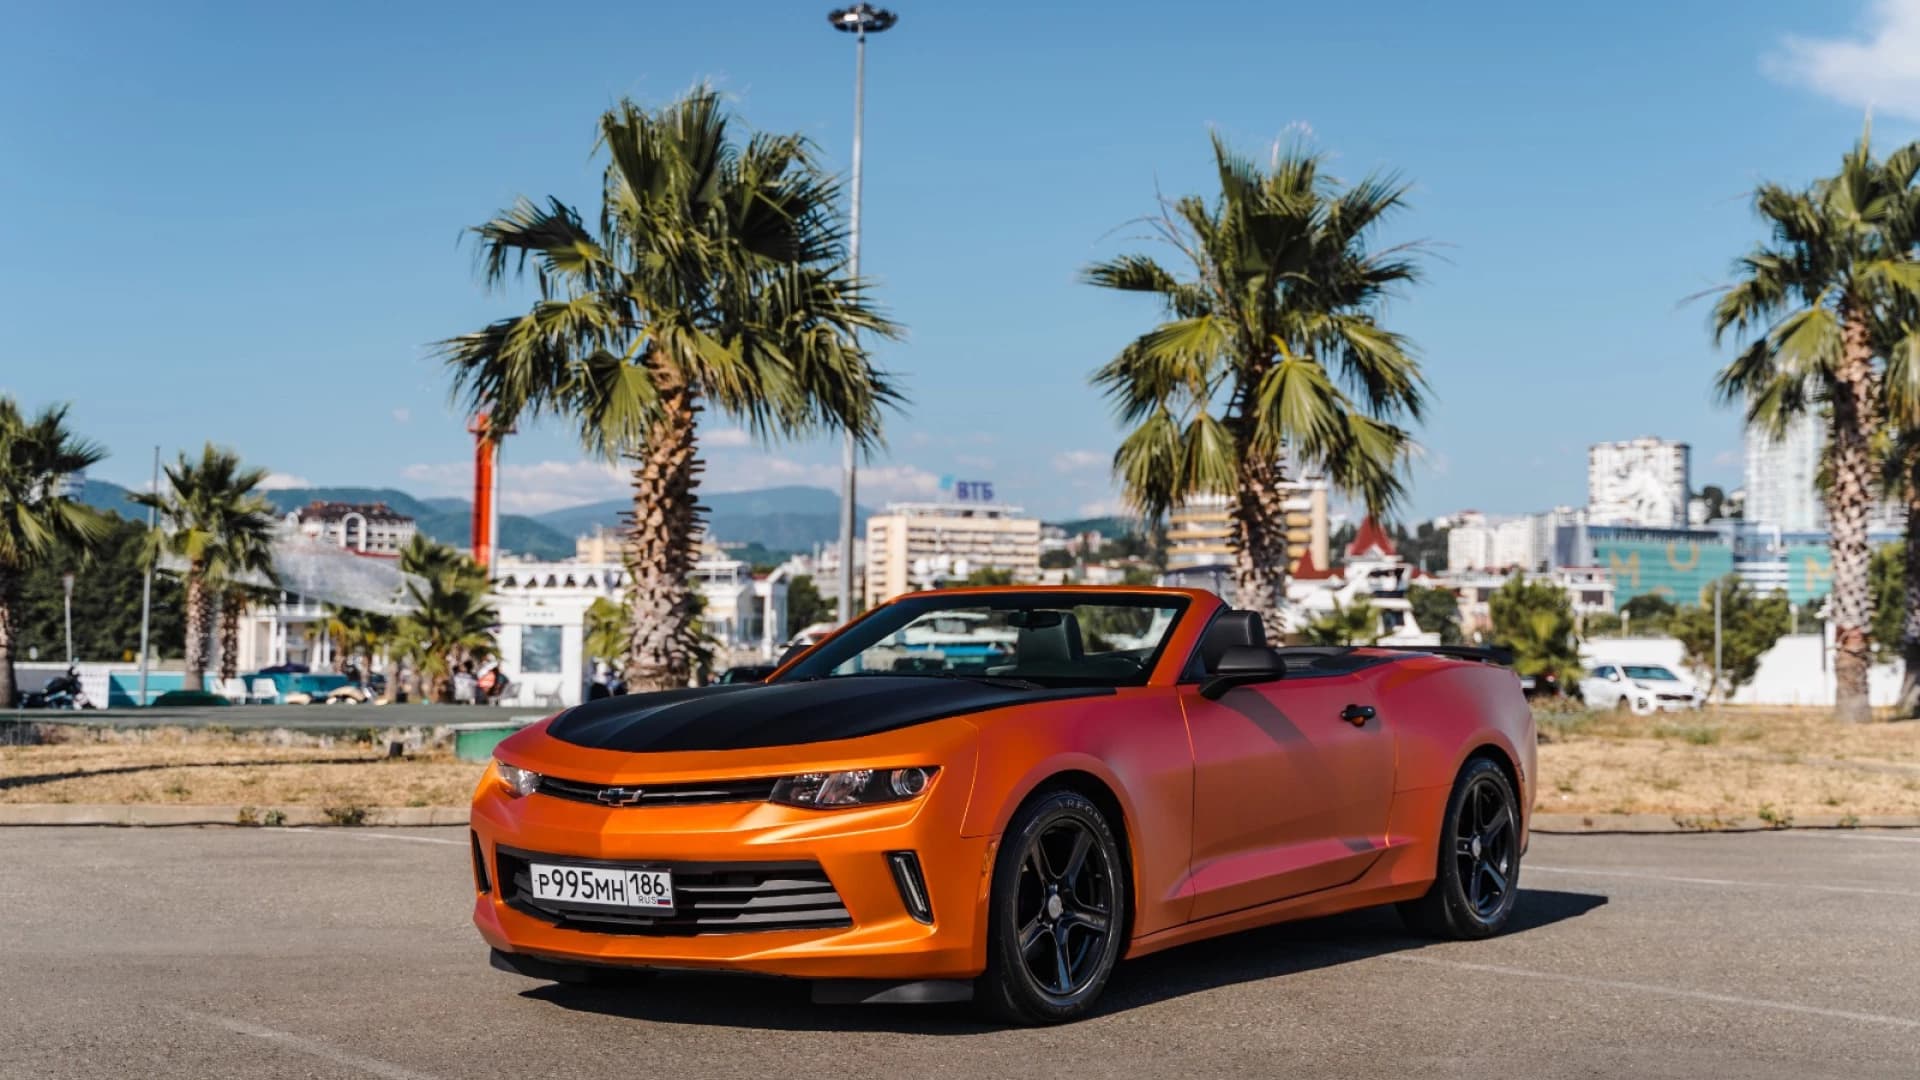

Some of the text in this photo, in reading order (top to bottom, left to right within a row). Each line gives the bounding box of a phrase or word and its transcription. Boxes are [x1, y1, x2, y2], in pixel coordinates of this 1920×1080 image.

[957, 481, 994, 500] ВТБ
[629, 873, 666, 896] 186
[638, 895, 657, 904] RUS
